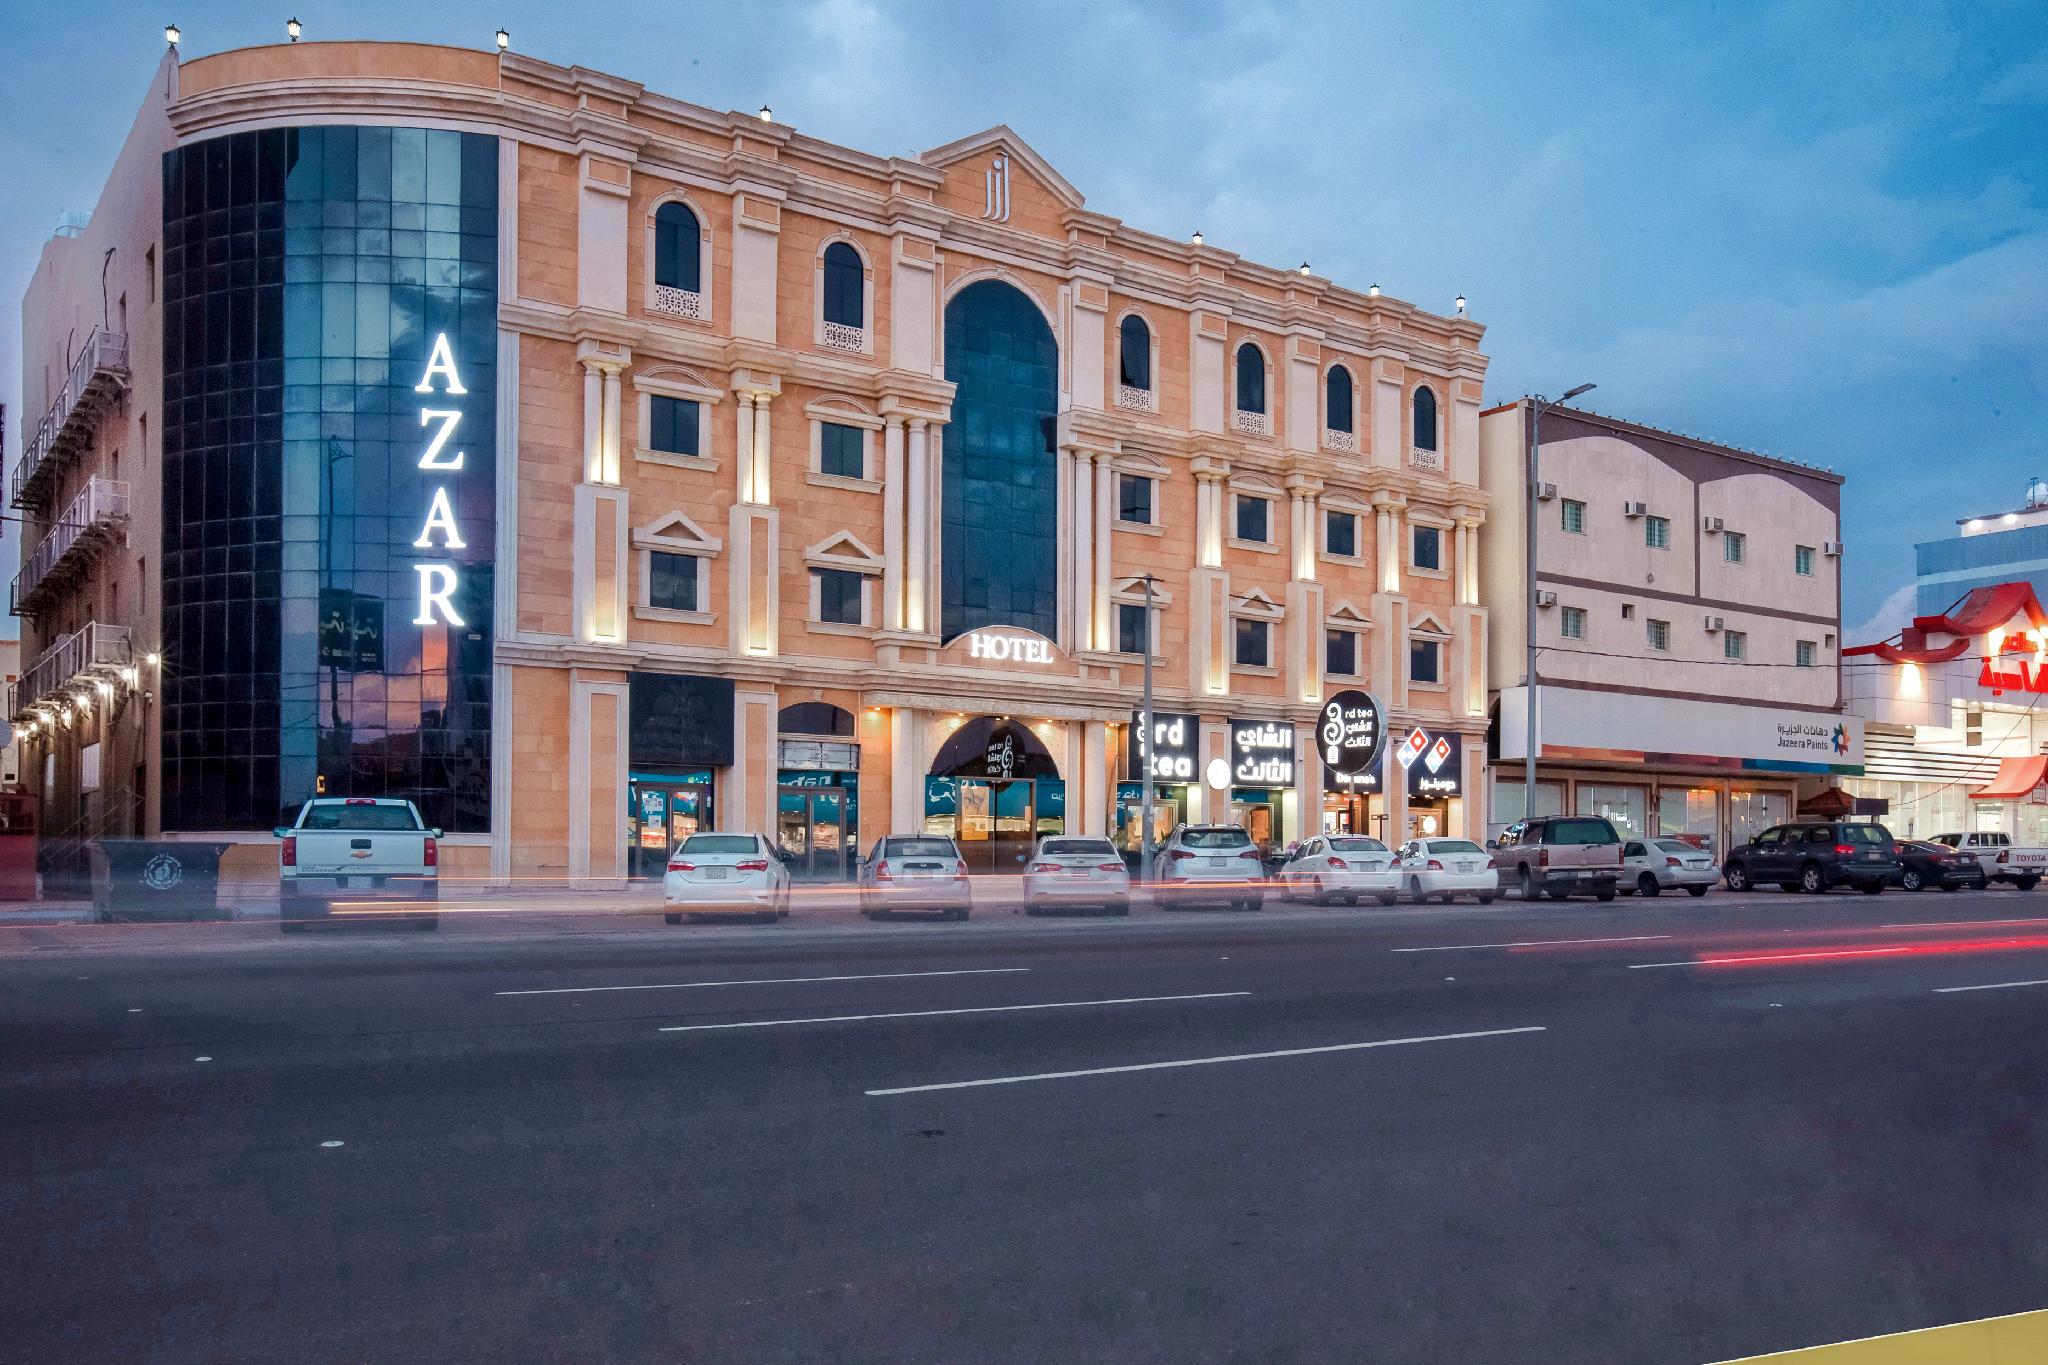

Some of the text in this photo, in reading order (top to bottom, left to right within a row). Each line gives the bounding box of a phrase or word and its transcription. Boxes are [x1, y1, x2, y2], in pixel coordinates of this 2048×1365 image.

[413, 332, 467, 626] AZAR
[970, 633, 1054, 664] HOTEL
[1236, 723, 1292, 752] الشاي
[1345, 720, 1372, 735] الشاي
[1777, 723, 1828, 736] دهانات الجزيرة
[1777, 736, 1828, 750] Jazeera Paints
[1151, 752, 1191, 777] tea
[1236, 757, 1292, 782] الثالث
[2015, 854, 2047, 862] TOYOTA
